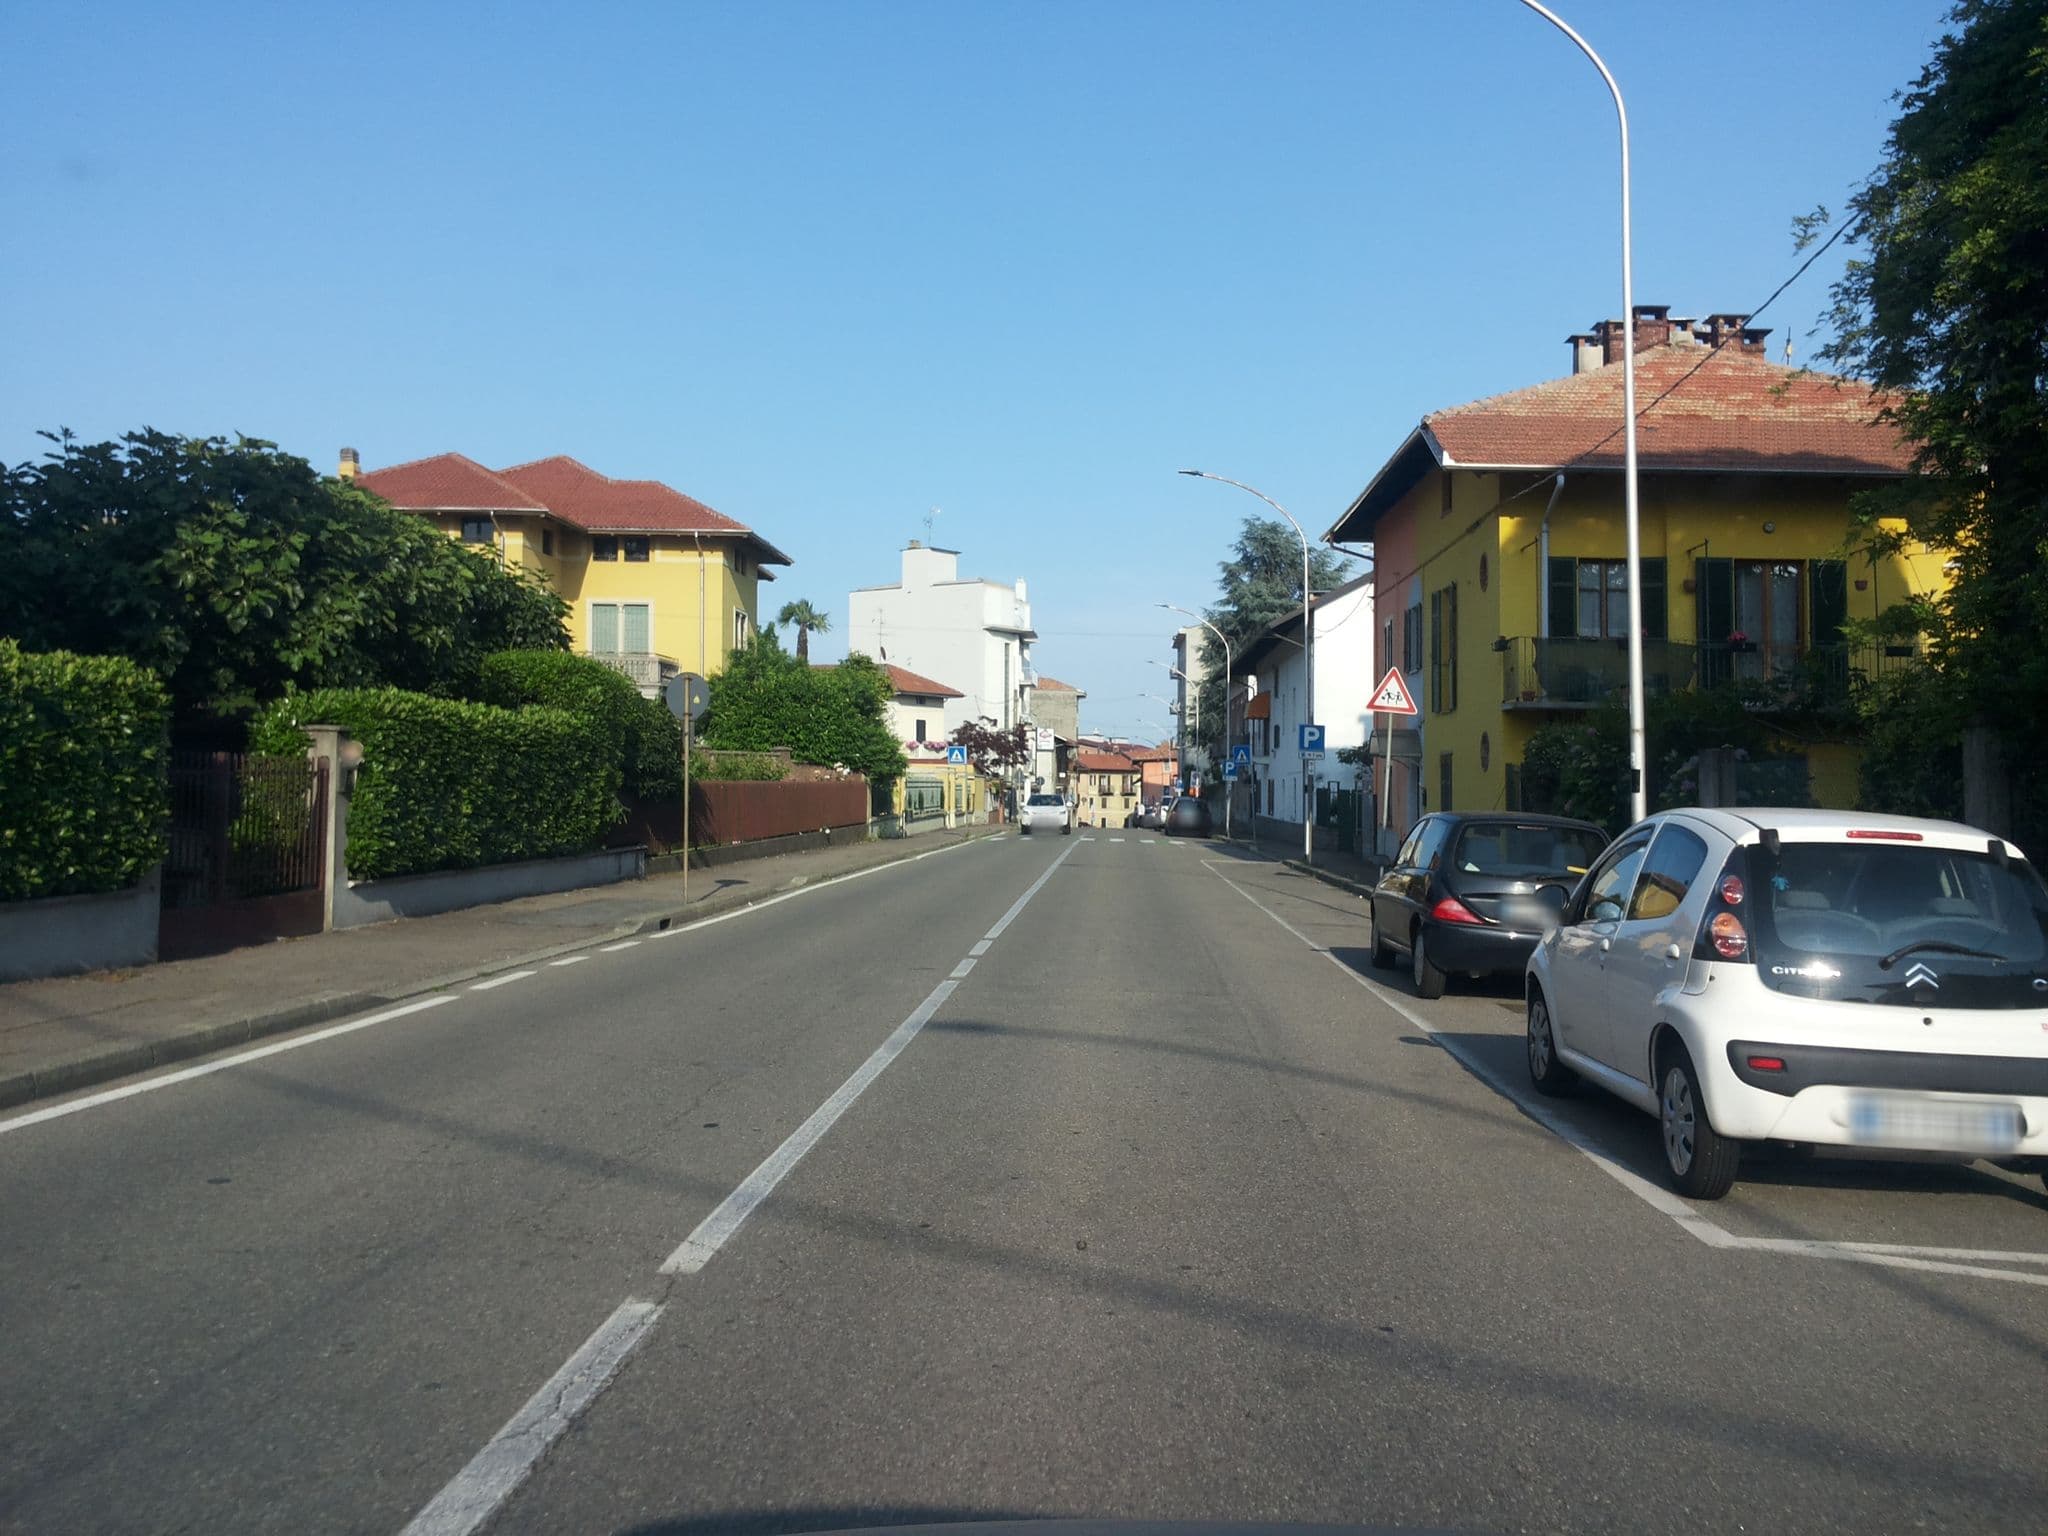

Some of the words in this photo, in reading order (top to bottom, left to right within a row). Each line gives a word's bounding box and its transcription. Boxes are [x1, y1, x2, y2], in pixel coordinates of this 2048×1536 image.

[1304, 728, 1319, 748] P
[1225, 761, 1235, 774] P
[1771, 965, 1841, 979] CITRN
